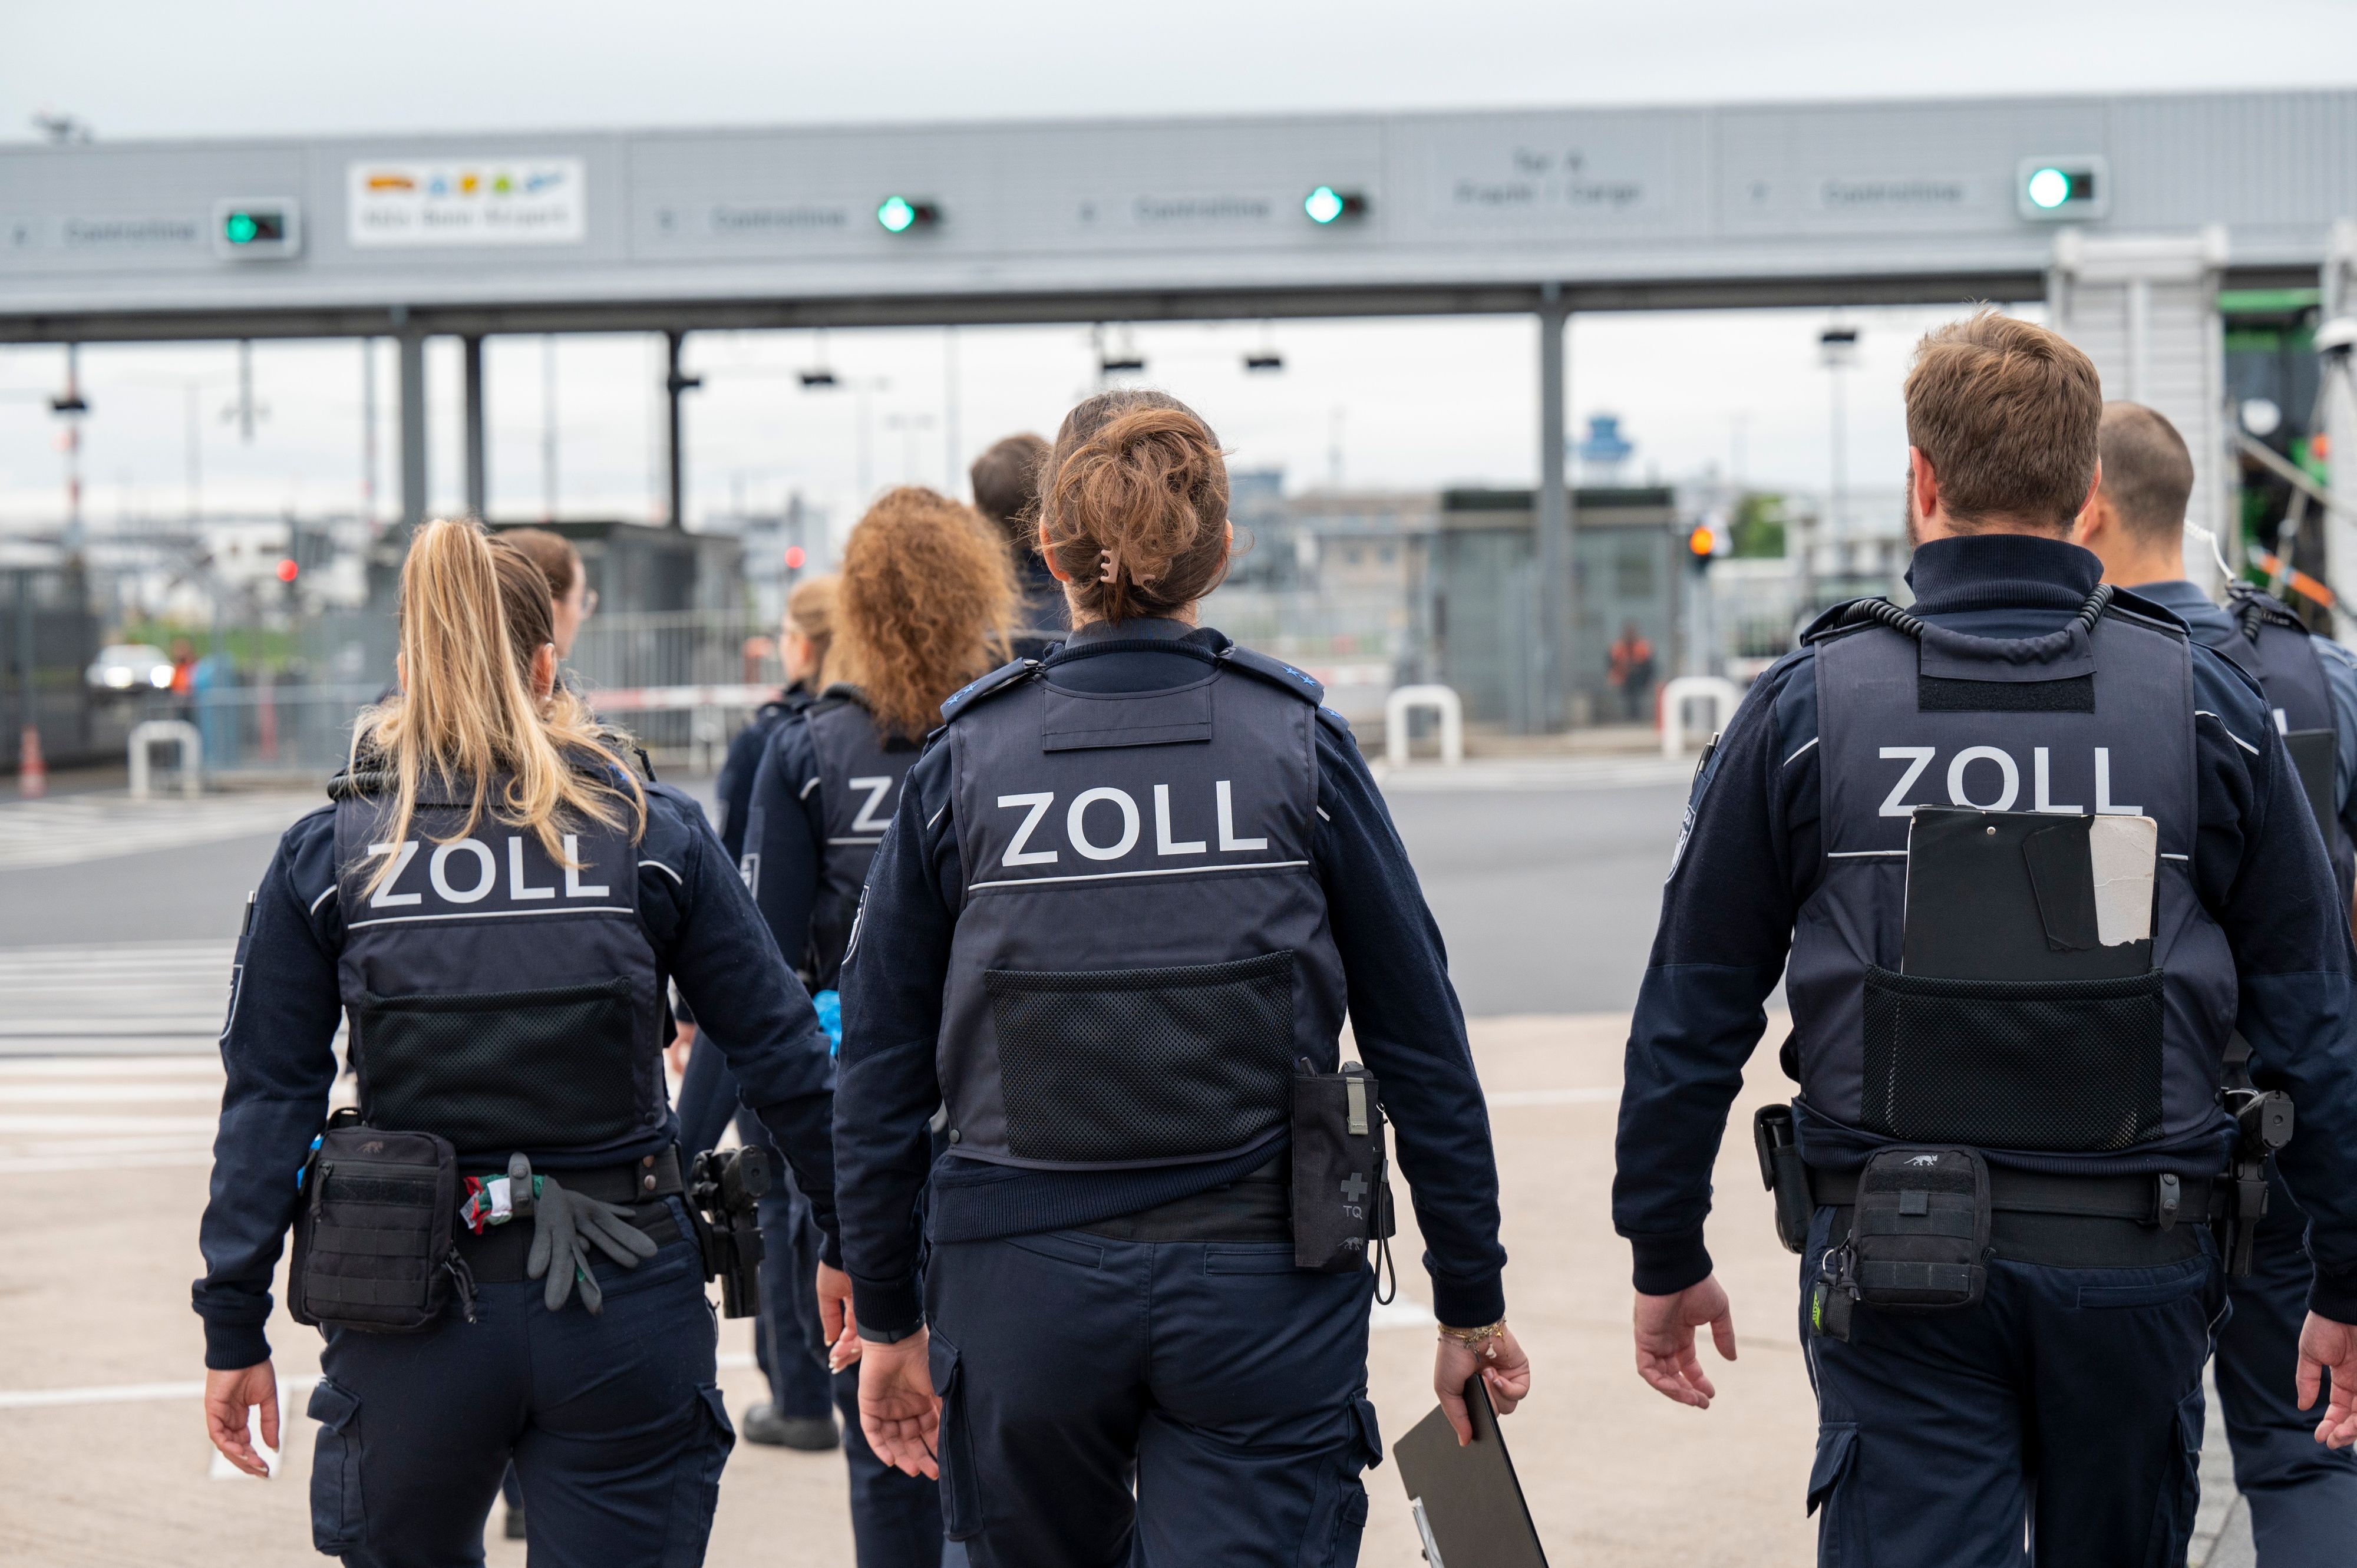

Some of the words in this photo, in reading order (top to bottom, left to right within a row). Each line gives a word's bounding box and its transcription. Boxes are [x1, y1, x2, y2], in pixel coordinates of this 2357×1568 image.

[1879, 745, 2143, 817] ZOLL
[997, 780, 1268, 867] ZOLL
[367, 834, 610, 908] ZOLL
[1343, 1205, 1363, 1220] TQ
